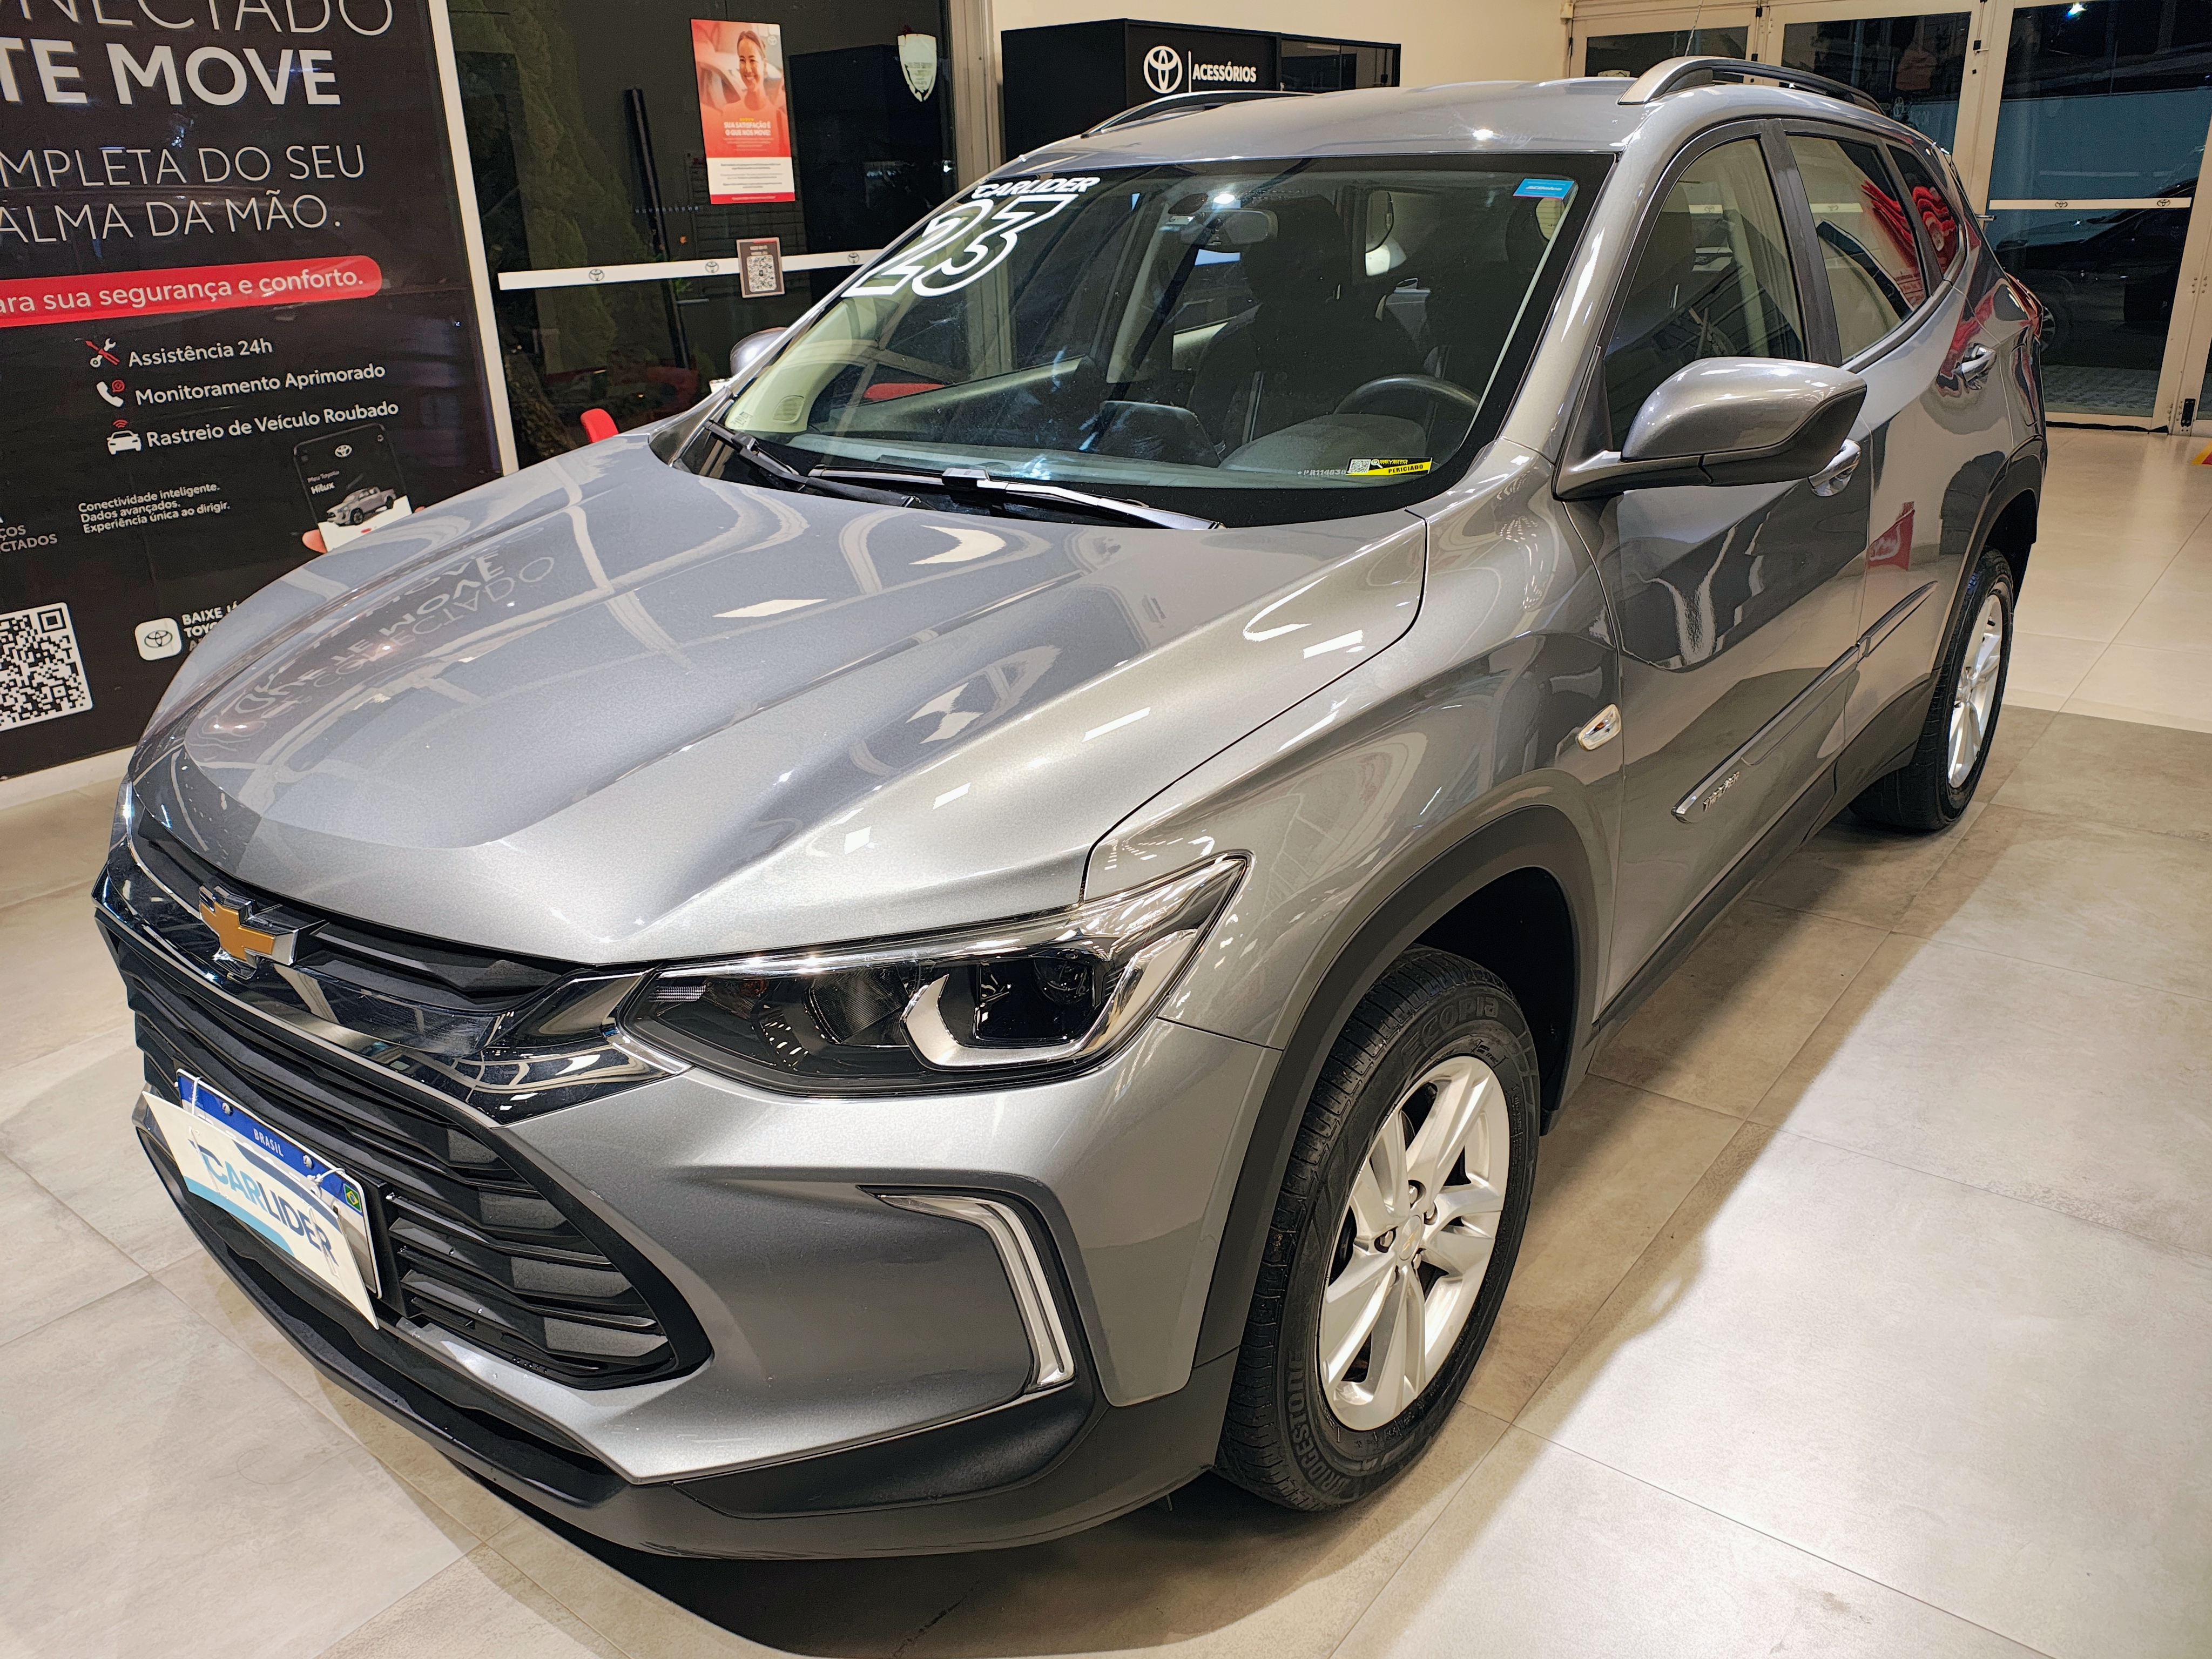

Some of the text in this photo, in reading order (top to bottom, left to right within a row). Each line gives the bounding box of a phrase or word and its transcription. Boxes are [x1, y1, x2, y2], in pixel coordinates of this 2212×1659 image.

[0, 37, 341, 106] TE MOVE
[1192, 61, 1257, 83] ACESSÓRIOS
[0, 145, 364, 187] MPLETA DO SEU
[972, 177, 1100, 199] CARLIDER
[0, 190, 341, 242] ALMA DA MÃO.
[841, 198, 1078, 298] 23
[43, 292, 91, 311] sua
[98, 281, 232, 308] segurança
[238, 279, 253, 294] e
[259, 269, 363, 292] conforto.
[129, 338, 273, 367] Assistência 24h
[136, 363, 386, 405] Monitoramento Aprimorado
[146, 401, 399, 447] Rastreio de Veículo Roubado
[1388, 464, 1424, 474] PERICIADO
[78, 483, 221, 512] Conectividade inteligente.
[311, 482, 335, 495] Hilux
[80, 500, 181, 523] Dados avançados.
[83, 501, 231, 534] Experiência única ao dirigir.
[182, 607, 223, 625] BAIXE
[253, 1128, 285, 1157] BRASIL
[188, 1138, 340, 1267] CARLIDER
